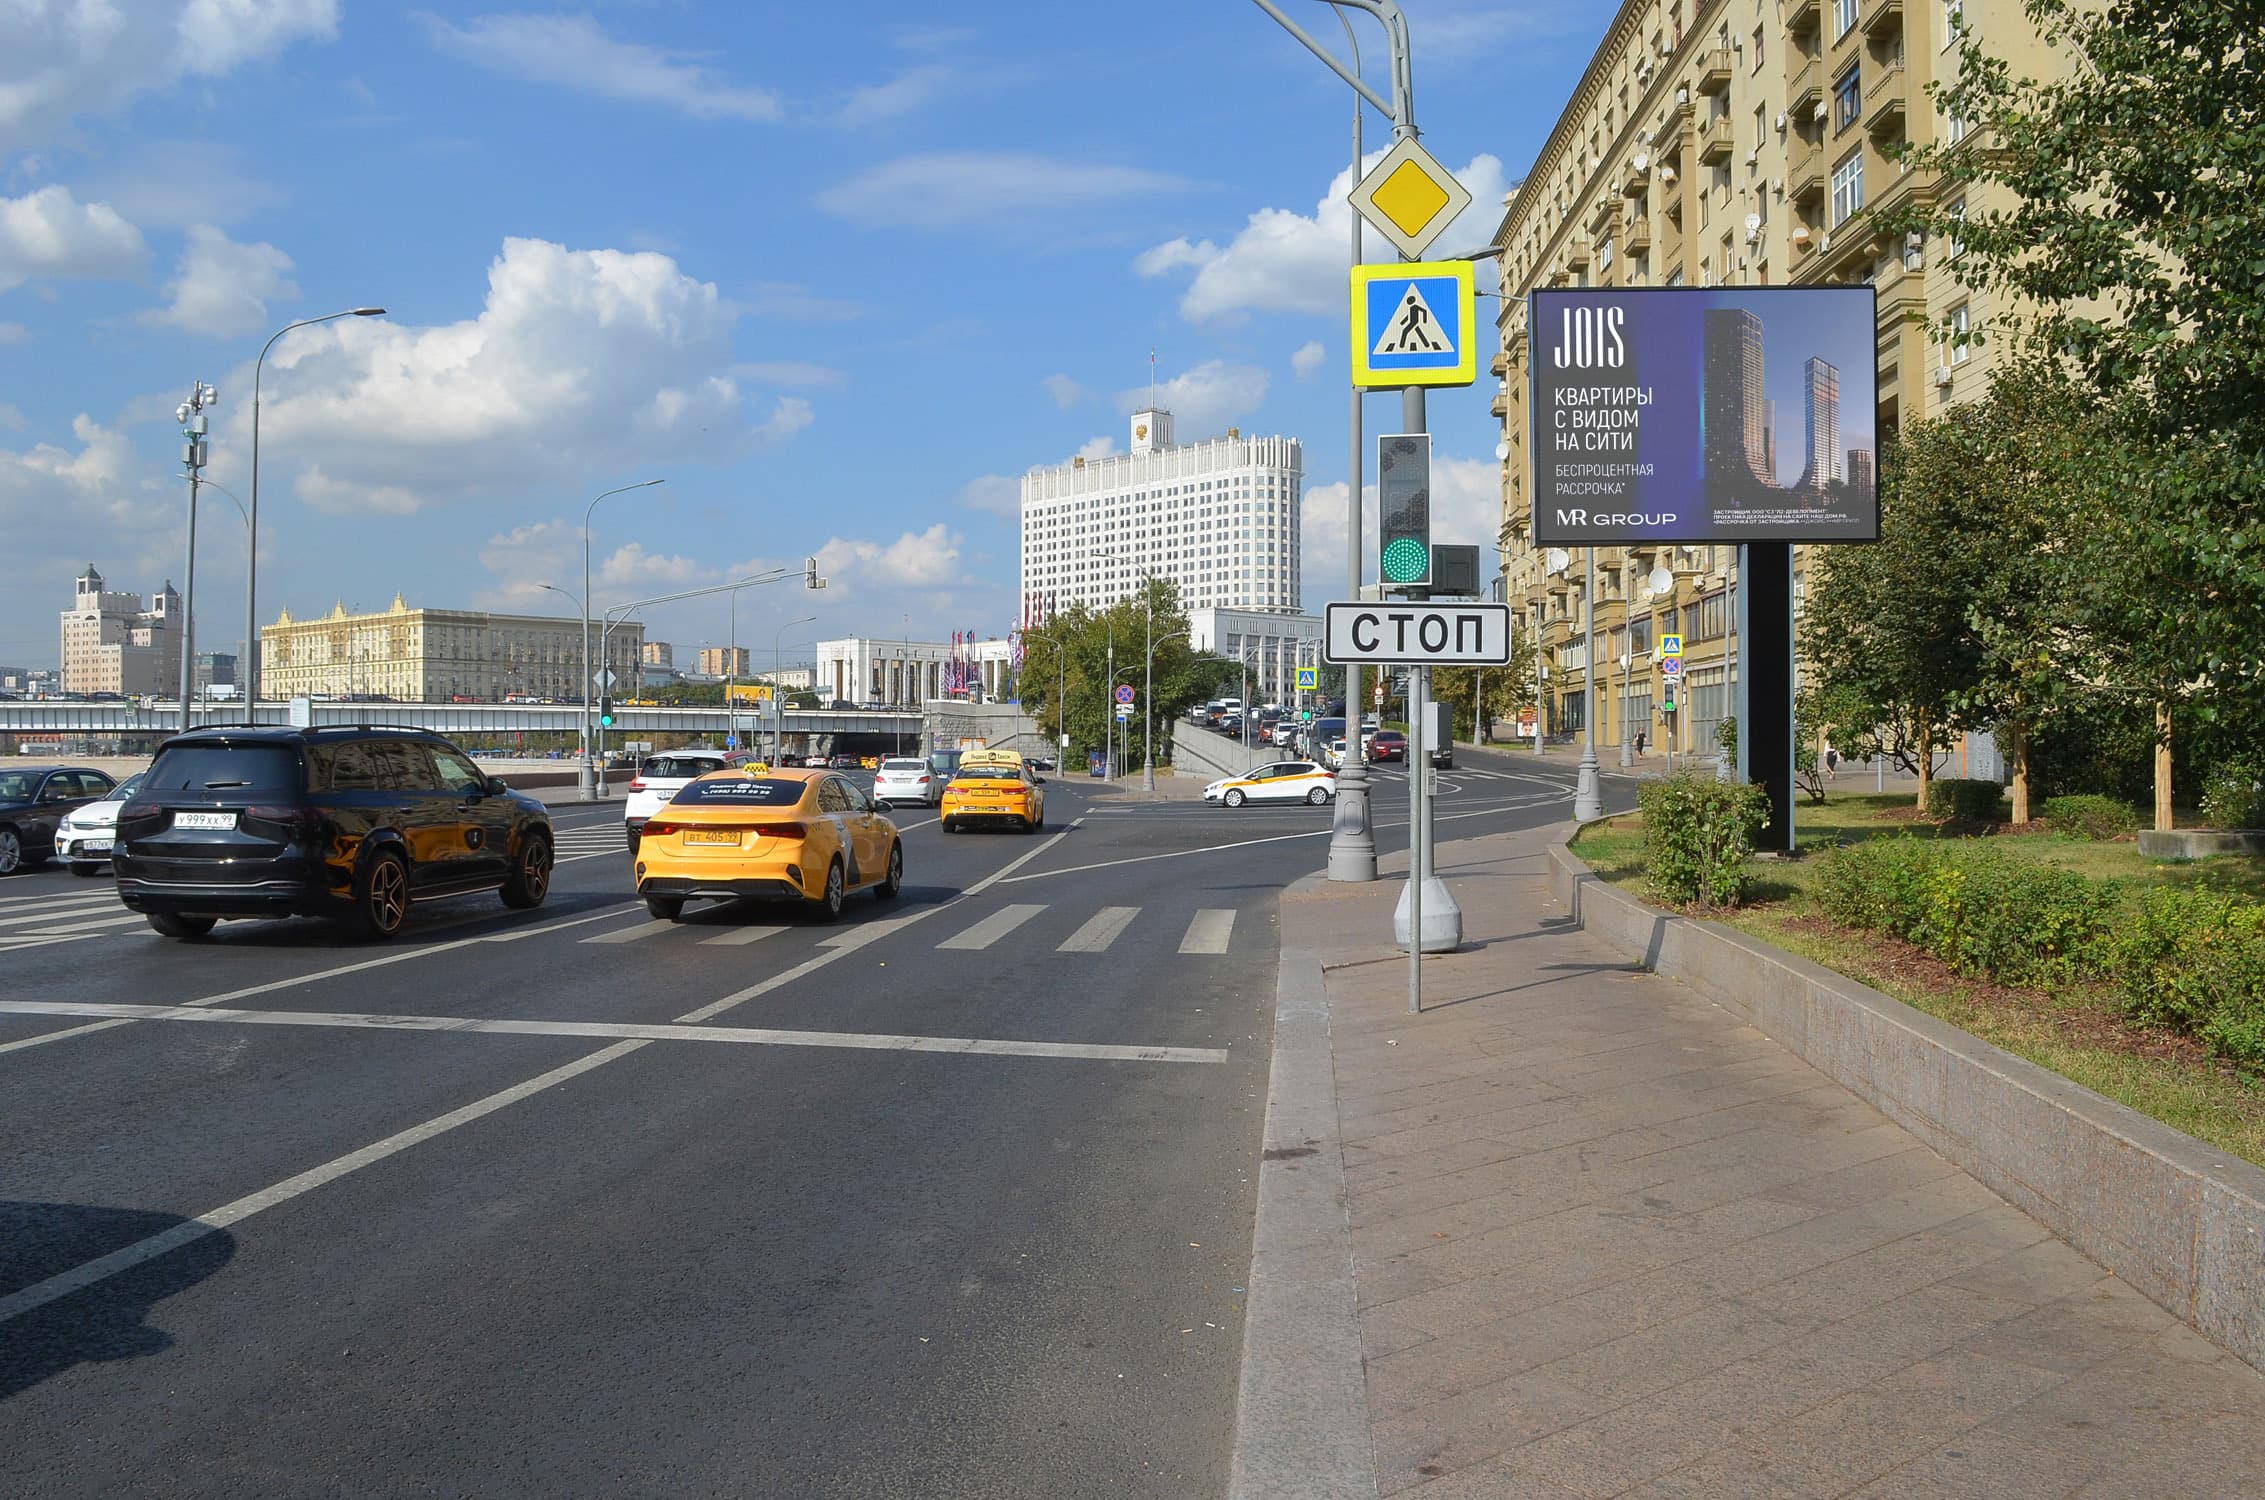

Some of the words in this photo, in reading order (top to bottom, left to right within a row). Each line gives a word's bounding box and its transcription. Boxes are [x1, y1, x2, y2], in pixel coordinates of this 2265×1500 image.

[1554, 306, 1625, 369] JOIS
[1554, 386, 1653, 406] КВАРТИРЫ
[1554, 409, 1567, 429] С
[1572, 409, 1639, 431] ВИДОМ
[1555, 432, 1580, 451] НА
[1585, 431, 1633, 451] СИТИ
[1555, 463, 1655, 478] БЕСПРОЦЕНТНАЯ
[1556, 508, 1588, 527] MR
[1593, 513, 1678, 526] GROUP
[1351, 612, 1483, 653] СТОП
